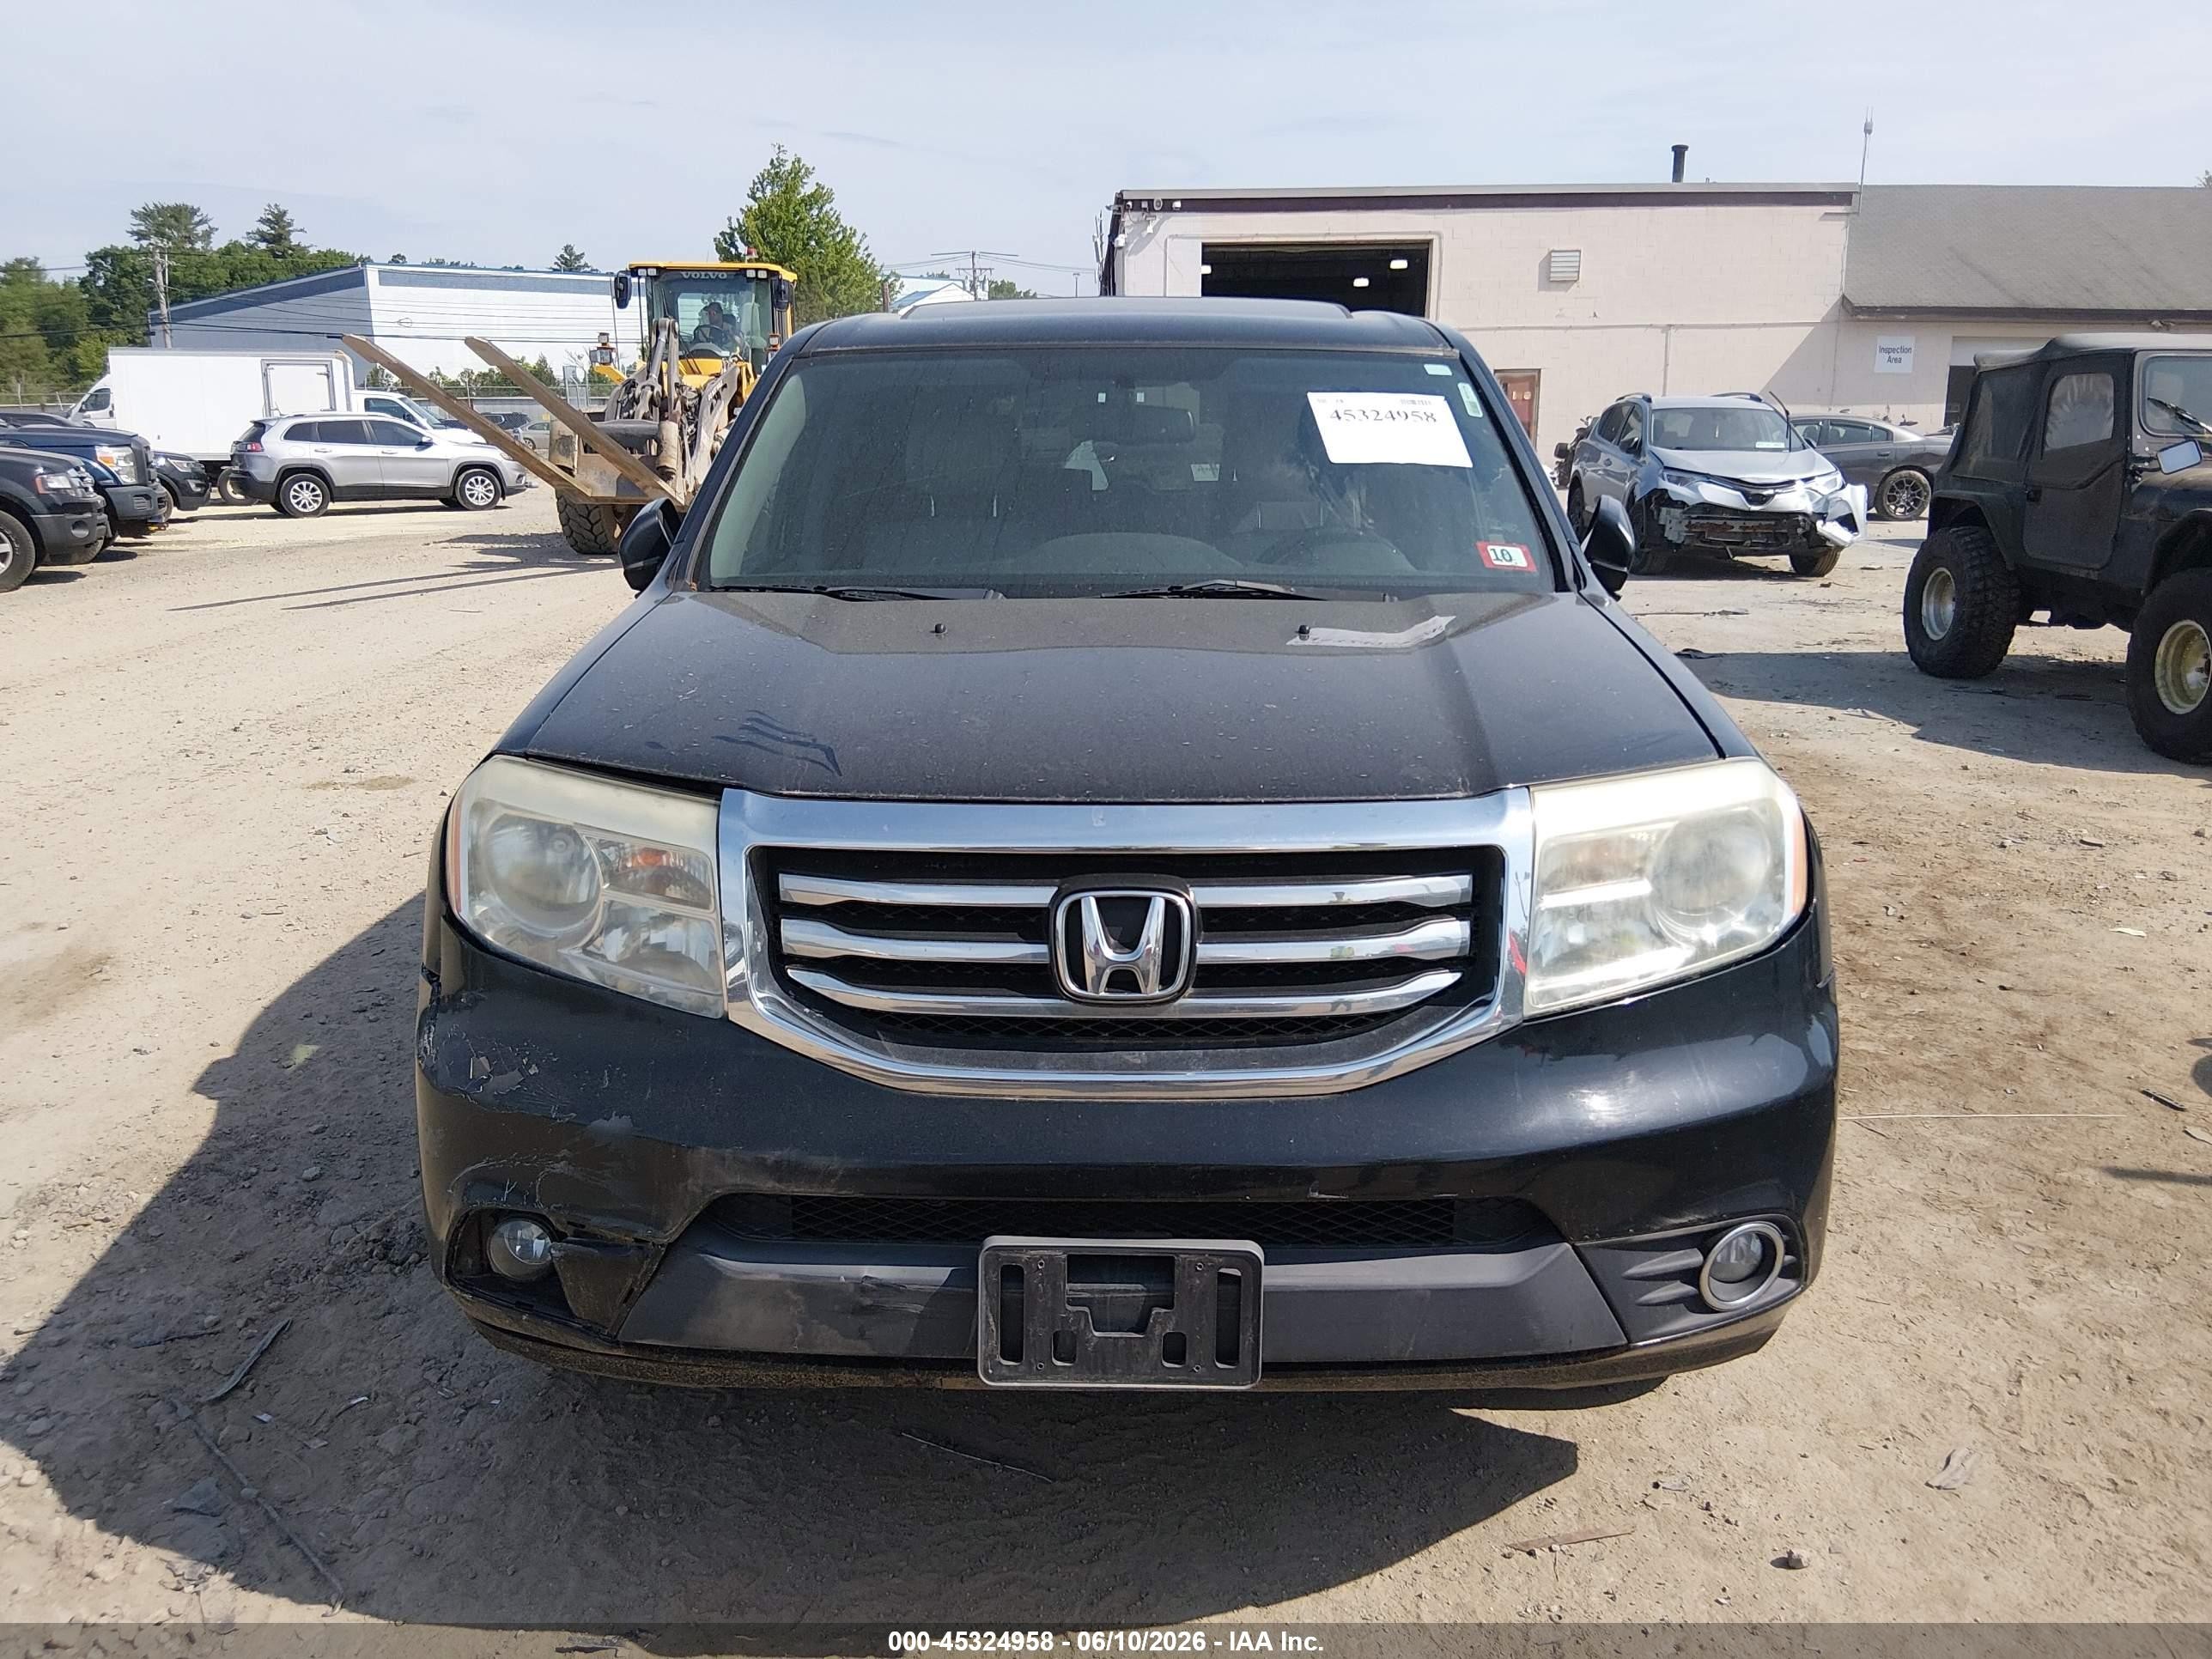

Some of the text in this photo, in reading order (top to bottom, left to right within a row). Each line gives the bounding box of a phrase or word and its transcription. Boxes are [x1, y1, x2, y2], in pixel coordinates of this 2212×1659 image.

[1878, 345, 1912, 355] Inspection
[1887, 356, 1902, 364] Area
[1330, 409, 1437, 422] 45324958
[1490, 548, 1512, 562] 10
